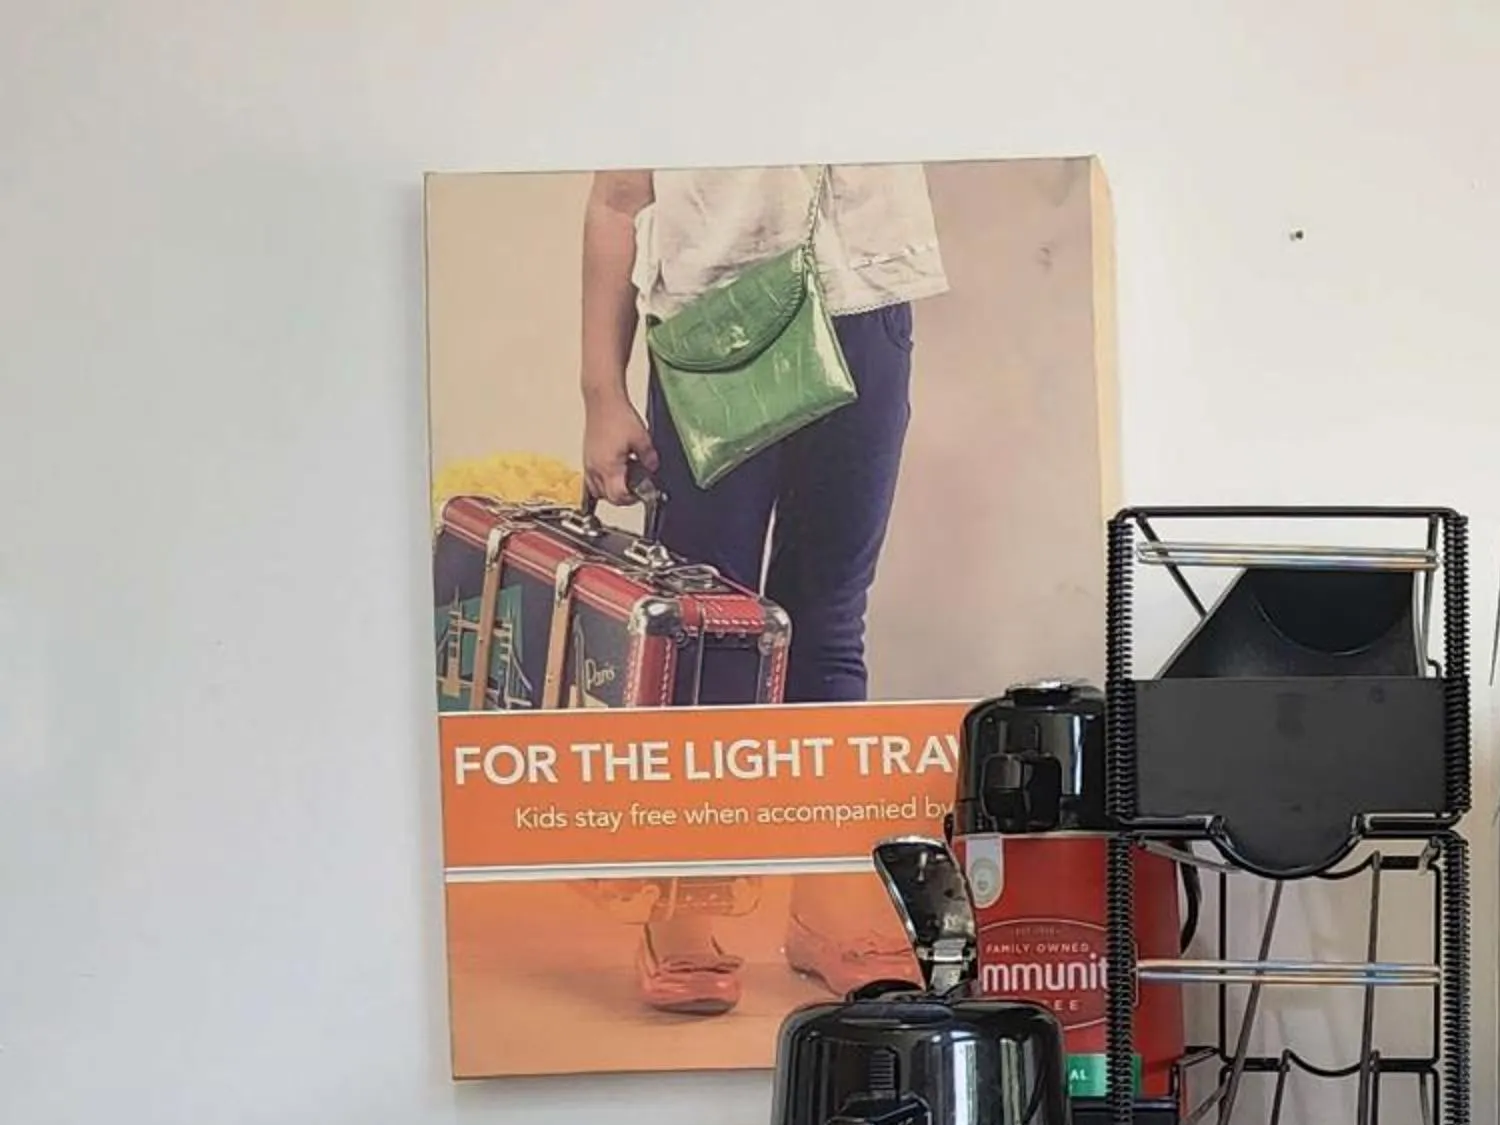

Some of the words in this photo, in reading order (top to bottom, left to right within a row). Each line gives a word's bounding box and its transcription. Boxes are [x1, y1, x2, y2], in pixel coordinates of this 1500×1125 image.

[455, 745, 559, 785] FOR
[570, 741, 671, 782] THE
[685, 738, 834, 780] LIGHT
[516, 805, 568, 828] Kids
[575, 809, 622, 832] stay
[632, 803, 677, 825] free
[683, 801, 749, 825] when
[757, 800, 917, 828] accompanied
[986, 943, 1030, 954] FAMILY
[1036, 941, 1089, 952] OWNED
[982, 952, 1109, 992] mmunit
